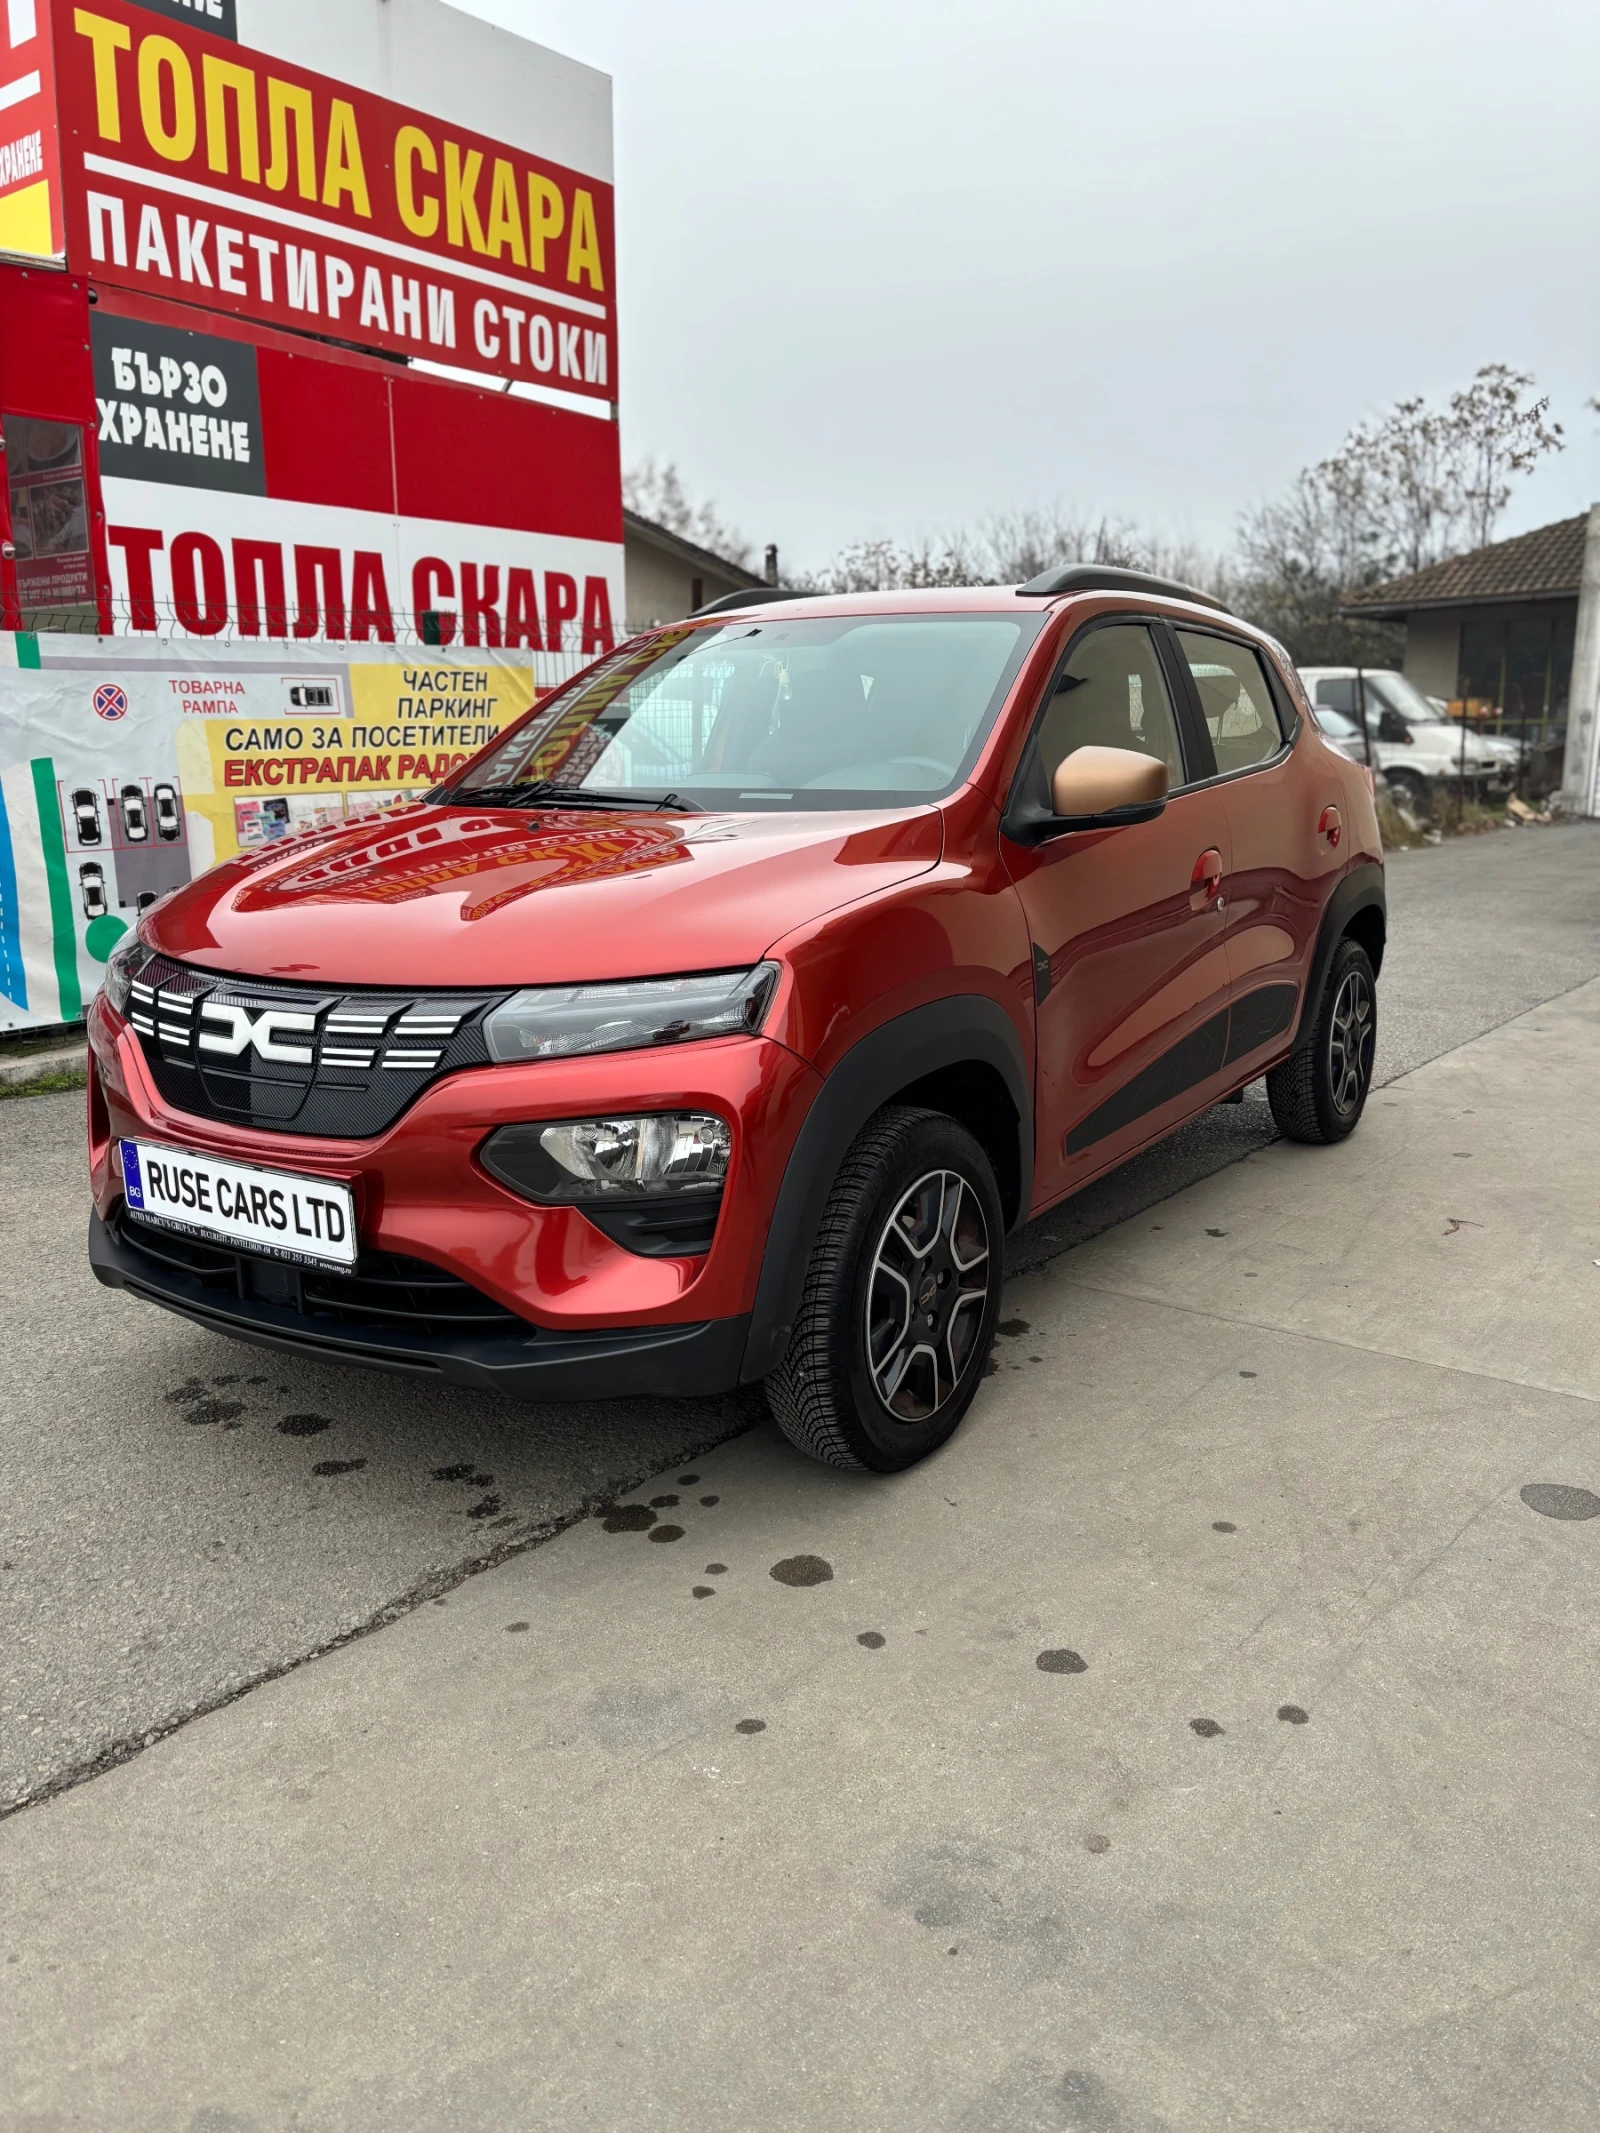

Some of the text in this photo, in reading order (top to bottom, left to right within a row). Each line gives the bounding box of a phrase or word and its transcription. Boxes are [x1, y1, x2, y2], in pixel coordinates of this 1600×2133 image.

[74, 8, 605, 292] ТОПЛА СКАРА
[86, 190, 608, 386] ПАКЕТИРАНИ СТОКИ
[111, 347, 227, 407] БЪРЗО
[95, 398, 250, 463] ХРАНЕНЕ
[107, 524, 615, 655] ТОПЛА СКАРА
[168, 680, 245, 694] ТОВАРНА
[403, 670, 488, 692] ЧАСТЕН
[182, 700, 238, 714] РАМПА
[398, 698, 498, 719] ПАРКИНГ
[225, 725, 499, 751] САМО ЗА ПОСЕТИТЕЛИ
[224, 754, 391, 787] ЕКСТРАПАК
[129, 1185, 141, 1199] BG
[147, 1160, 346, 1243] RUSE CARS LTD
[129, 1210, 145, 1222] AUTO
